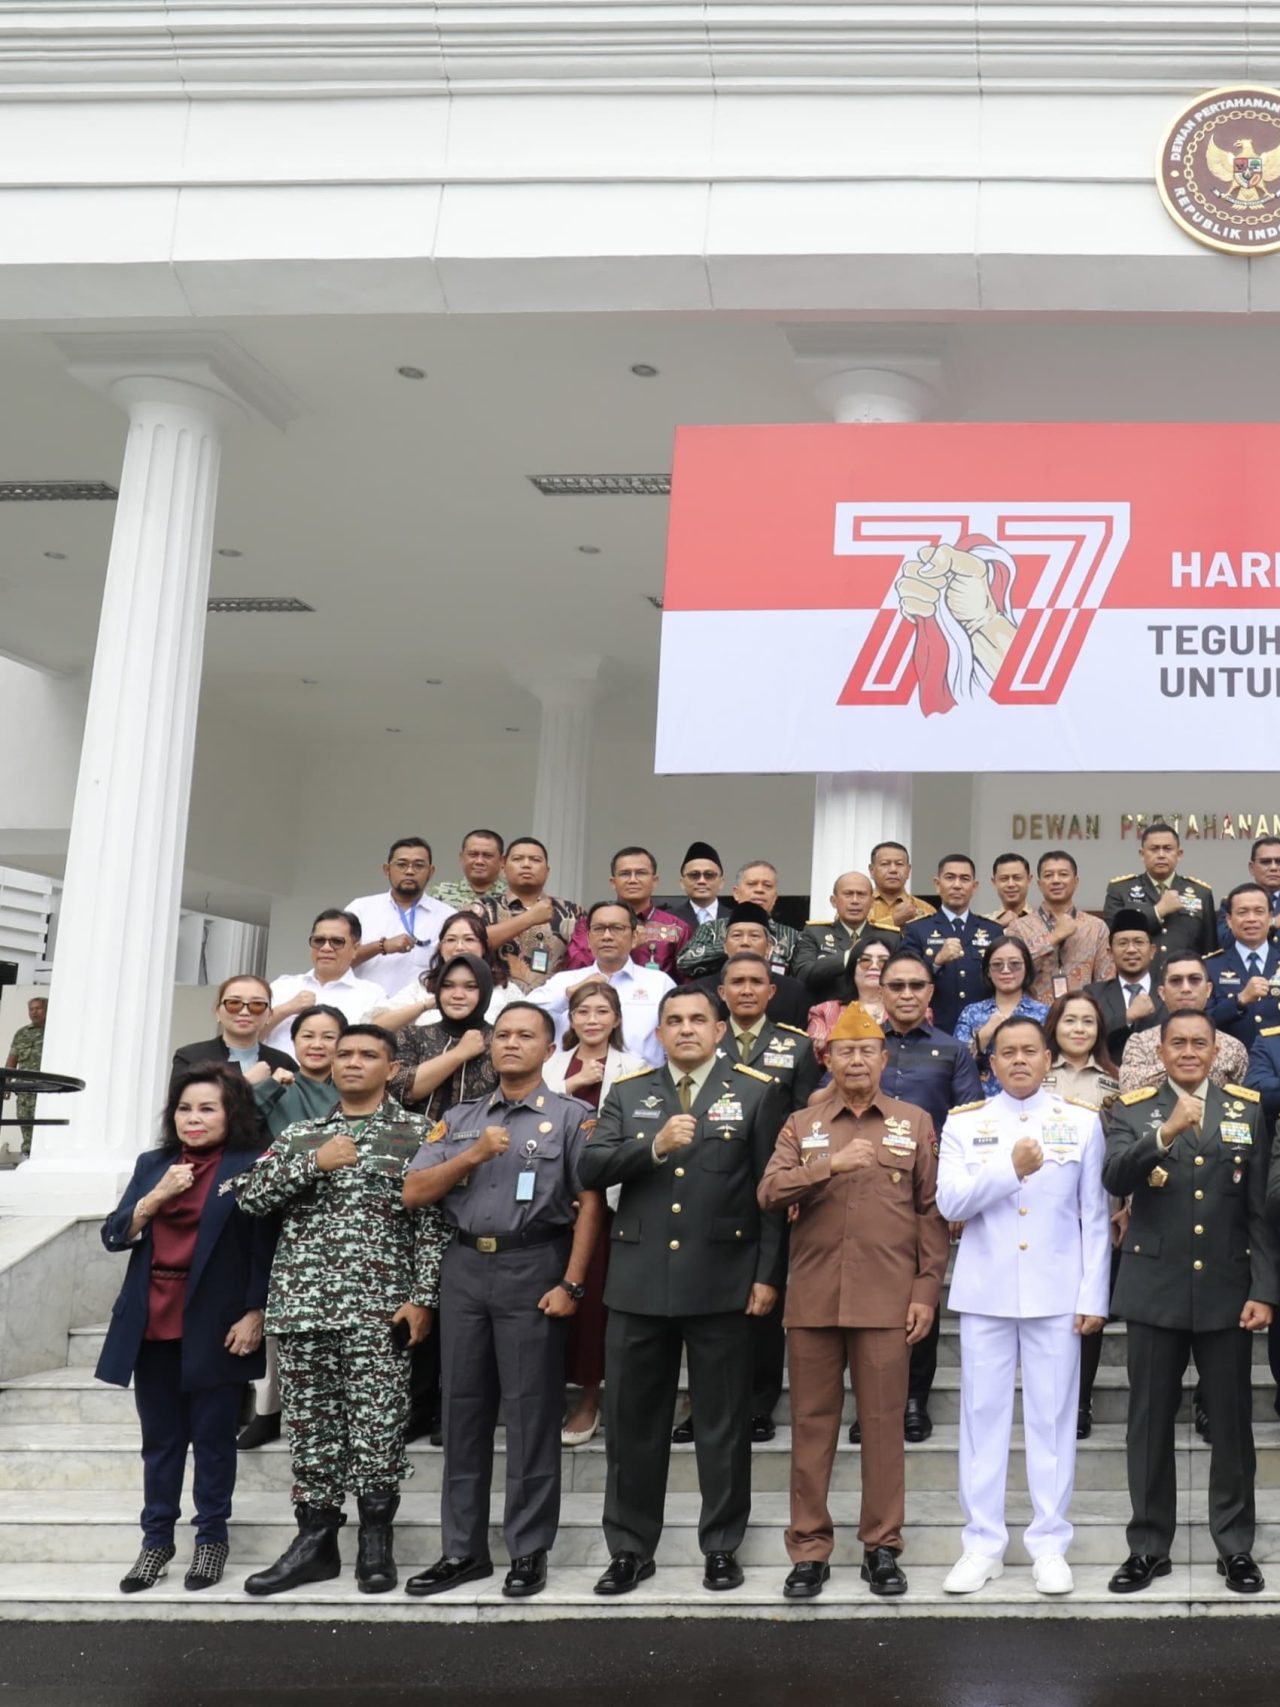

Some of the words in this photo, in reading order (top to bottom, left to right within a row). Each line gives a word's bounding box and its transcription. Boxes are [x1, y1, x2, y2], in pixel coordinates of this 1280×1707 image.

[1170, 120, 1197, 161] DEWAN
[1194, 98, 1280, 123] PERTAHANAN
[1174, 187, 1242, 240] REPUBLIK
[833, 502, 1131, 705] 77
[1012, 813, 1100, 840] DEWAN
